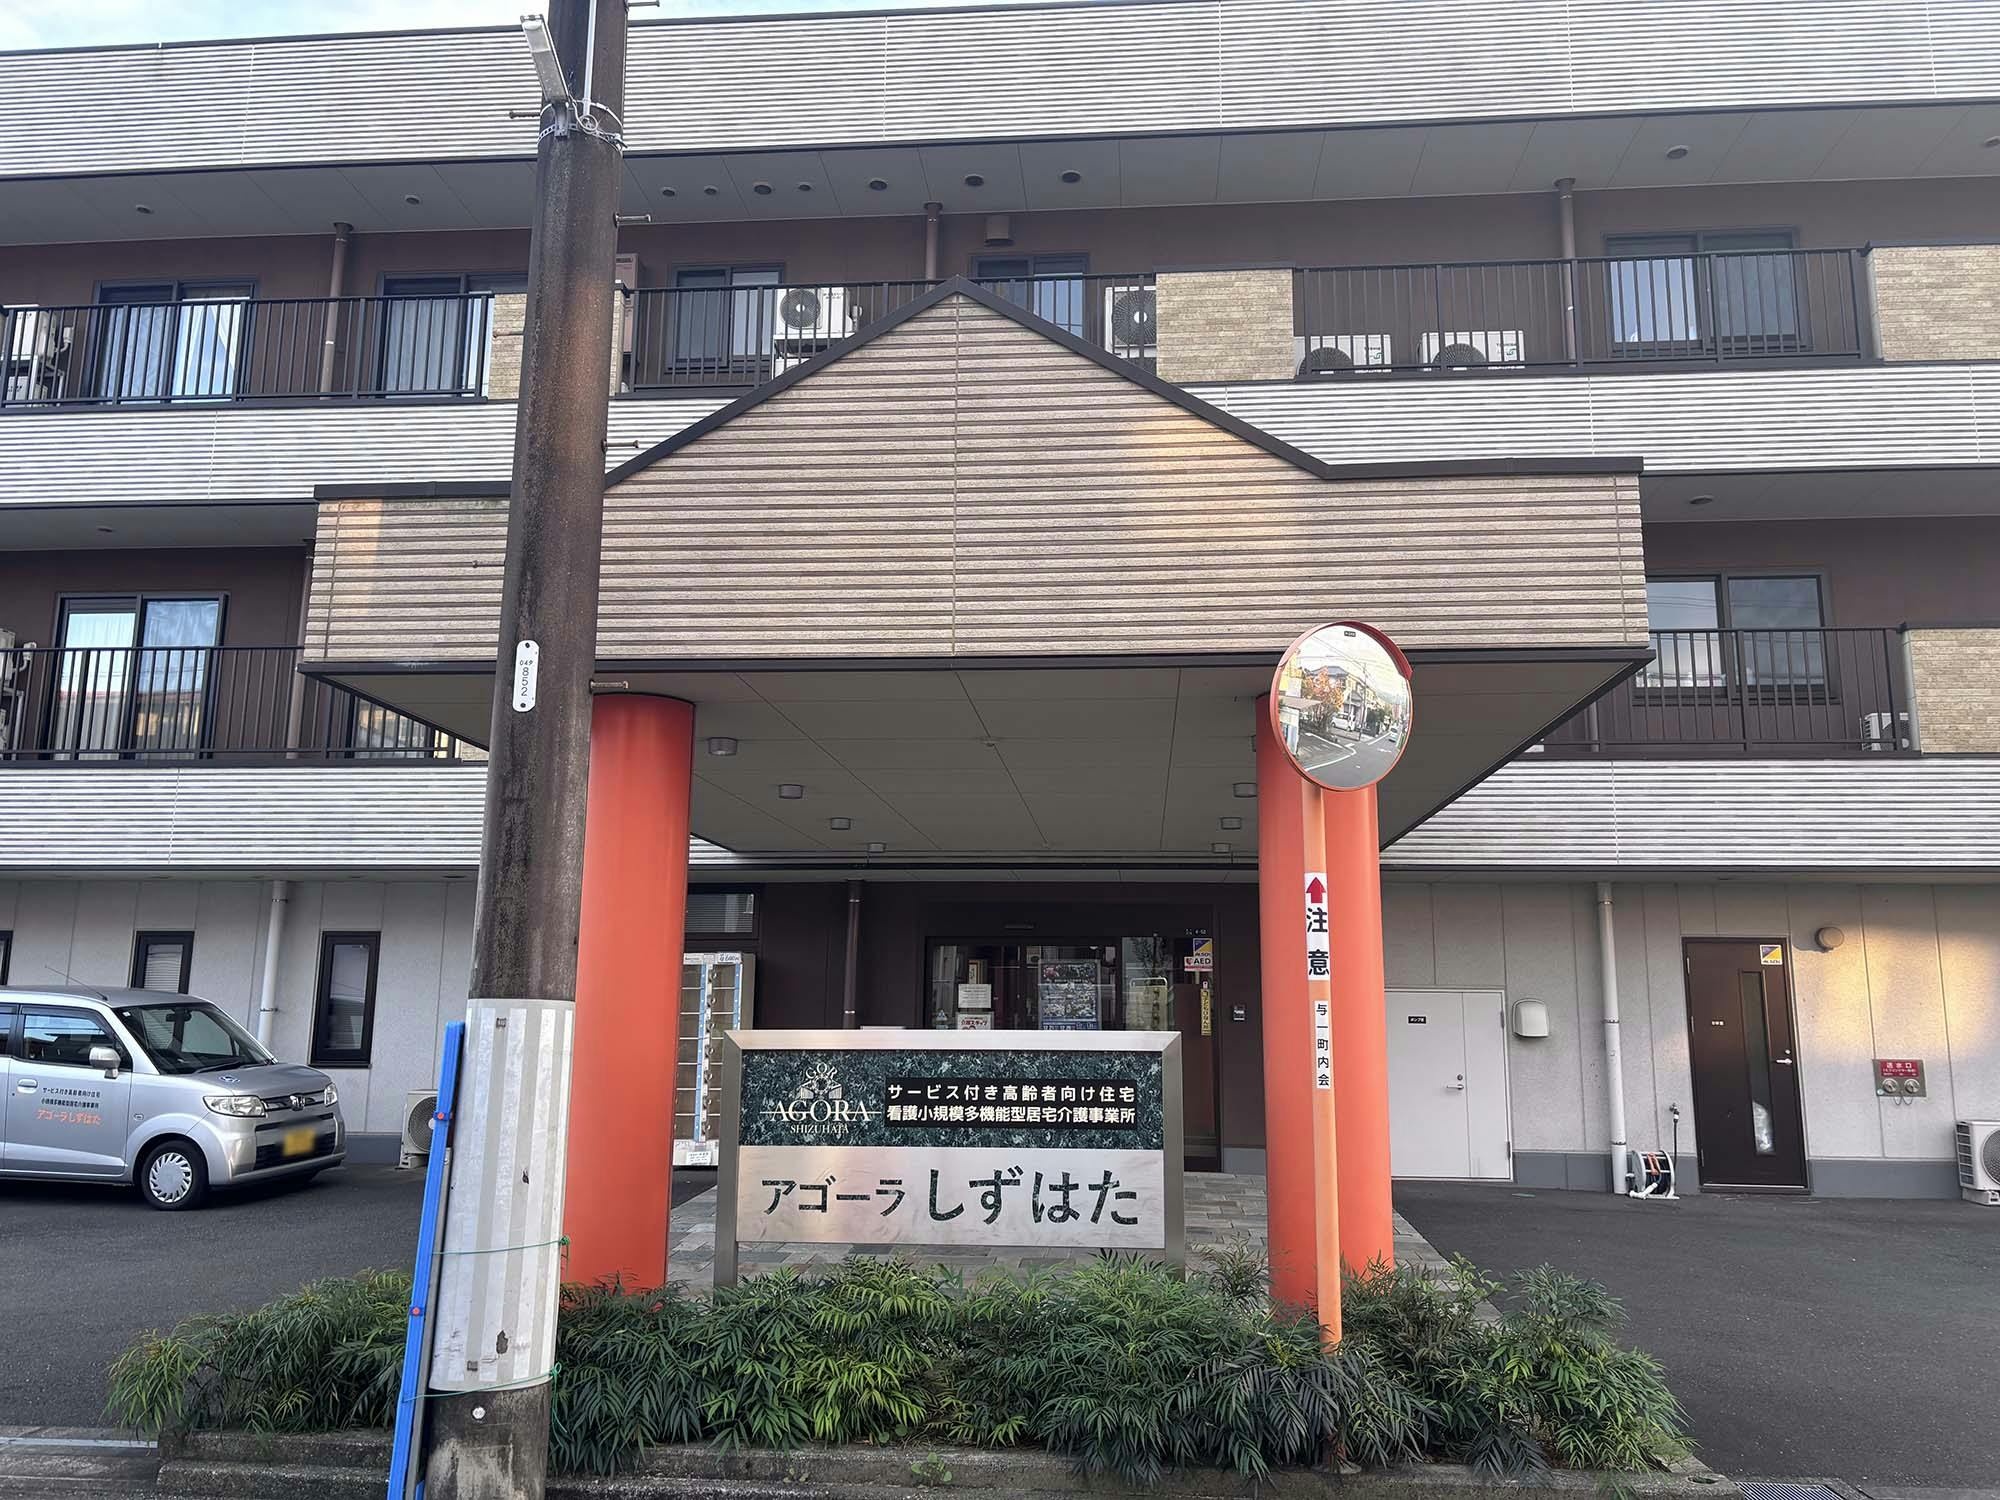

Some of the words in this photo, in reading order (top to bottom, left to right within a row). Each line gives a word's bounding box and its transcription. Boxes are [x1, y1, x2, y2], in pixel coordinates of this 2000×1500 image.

[521, 667, 529, 696] 852
[1306, 907, 1330, 975] 注意
[1194, 957, 1211, 965] AED
[1316, 1004, 1330, 1086] 与一町内会
[888, 1084, 1135, 1103] サービス付き高齢者向け住宅
[770, 1100, 872, 1122] AGORA
[886, 1105, 1135, 1124] 看護小規模多機能型居宅介護事業所
[790, 1124, 849, 1134] SHIZUHATA
